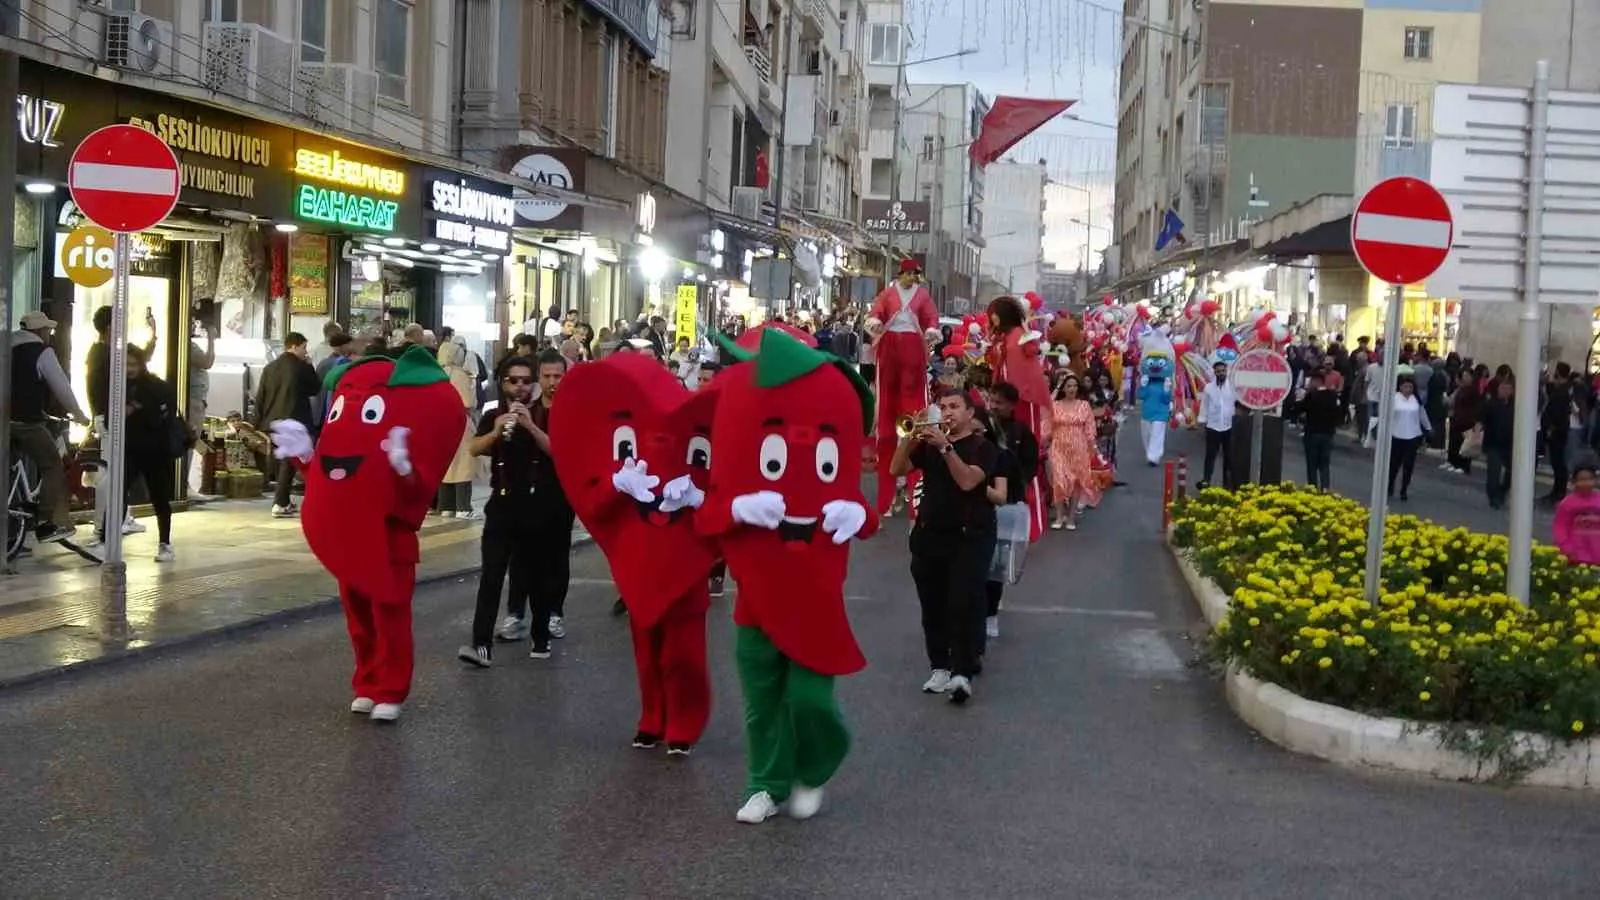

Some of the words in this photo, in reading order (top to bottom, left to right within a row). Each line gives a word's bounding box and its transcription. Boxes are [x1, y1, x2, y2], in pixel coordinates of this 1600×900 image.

[157, 113, 271, 167] SESLİOKUYUCU
[180, 163, 255, 198] UYUMCULUK
[299, 184, 398, 230] BAHARAT
[68, 235, 115, 269] ria
